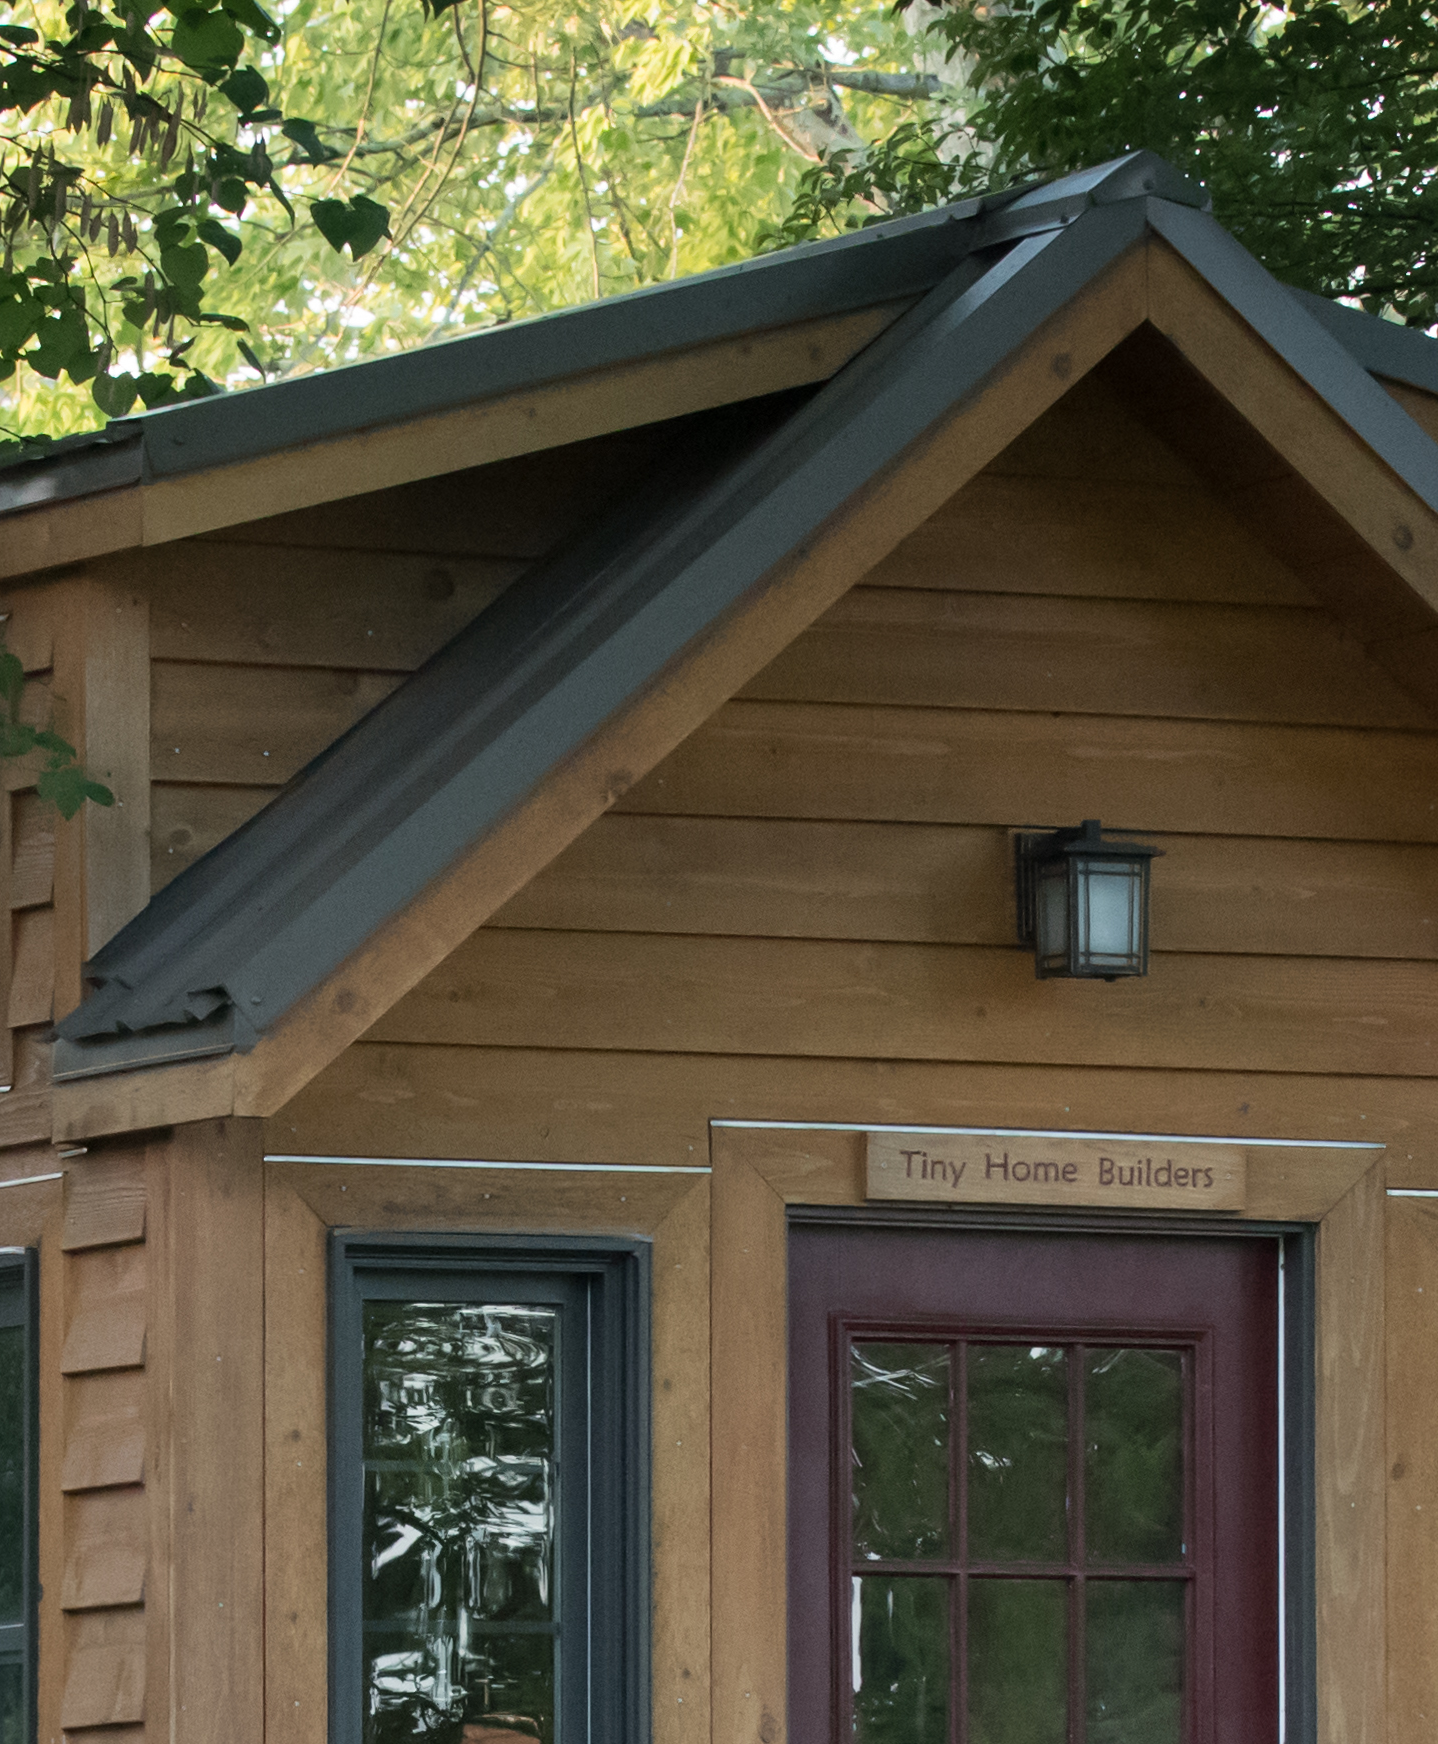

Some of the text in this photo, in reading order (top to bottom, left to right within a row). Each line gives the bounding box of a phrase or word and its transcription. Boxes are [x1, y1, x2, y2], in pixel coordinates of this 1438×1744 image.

[899, 1149, 1215, 1189] Tiny Home Builders
